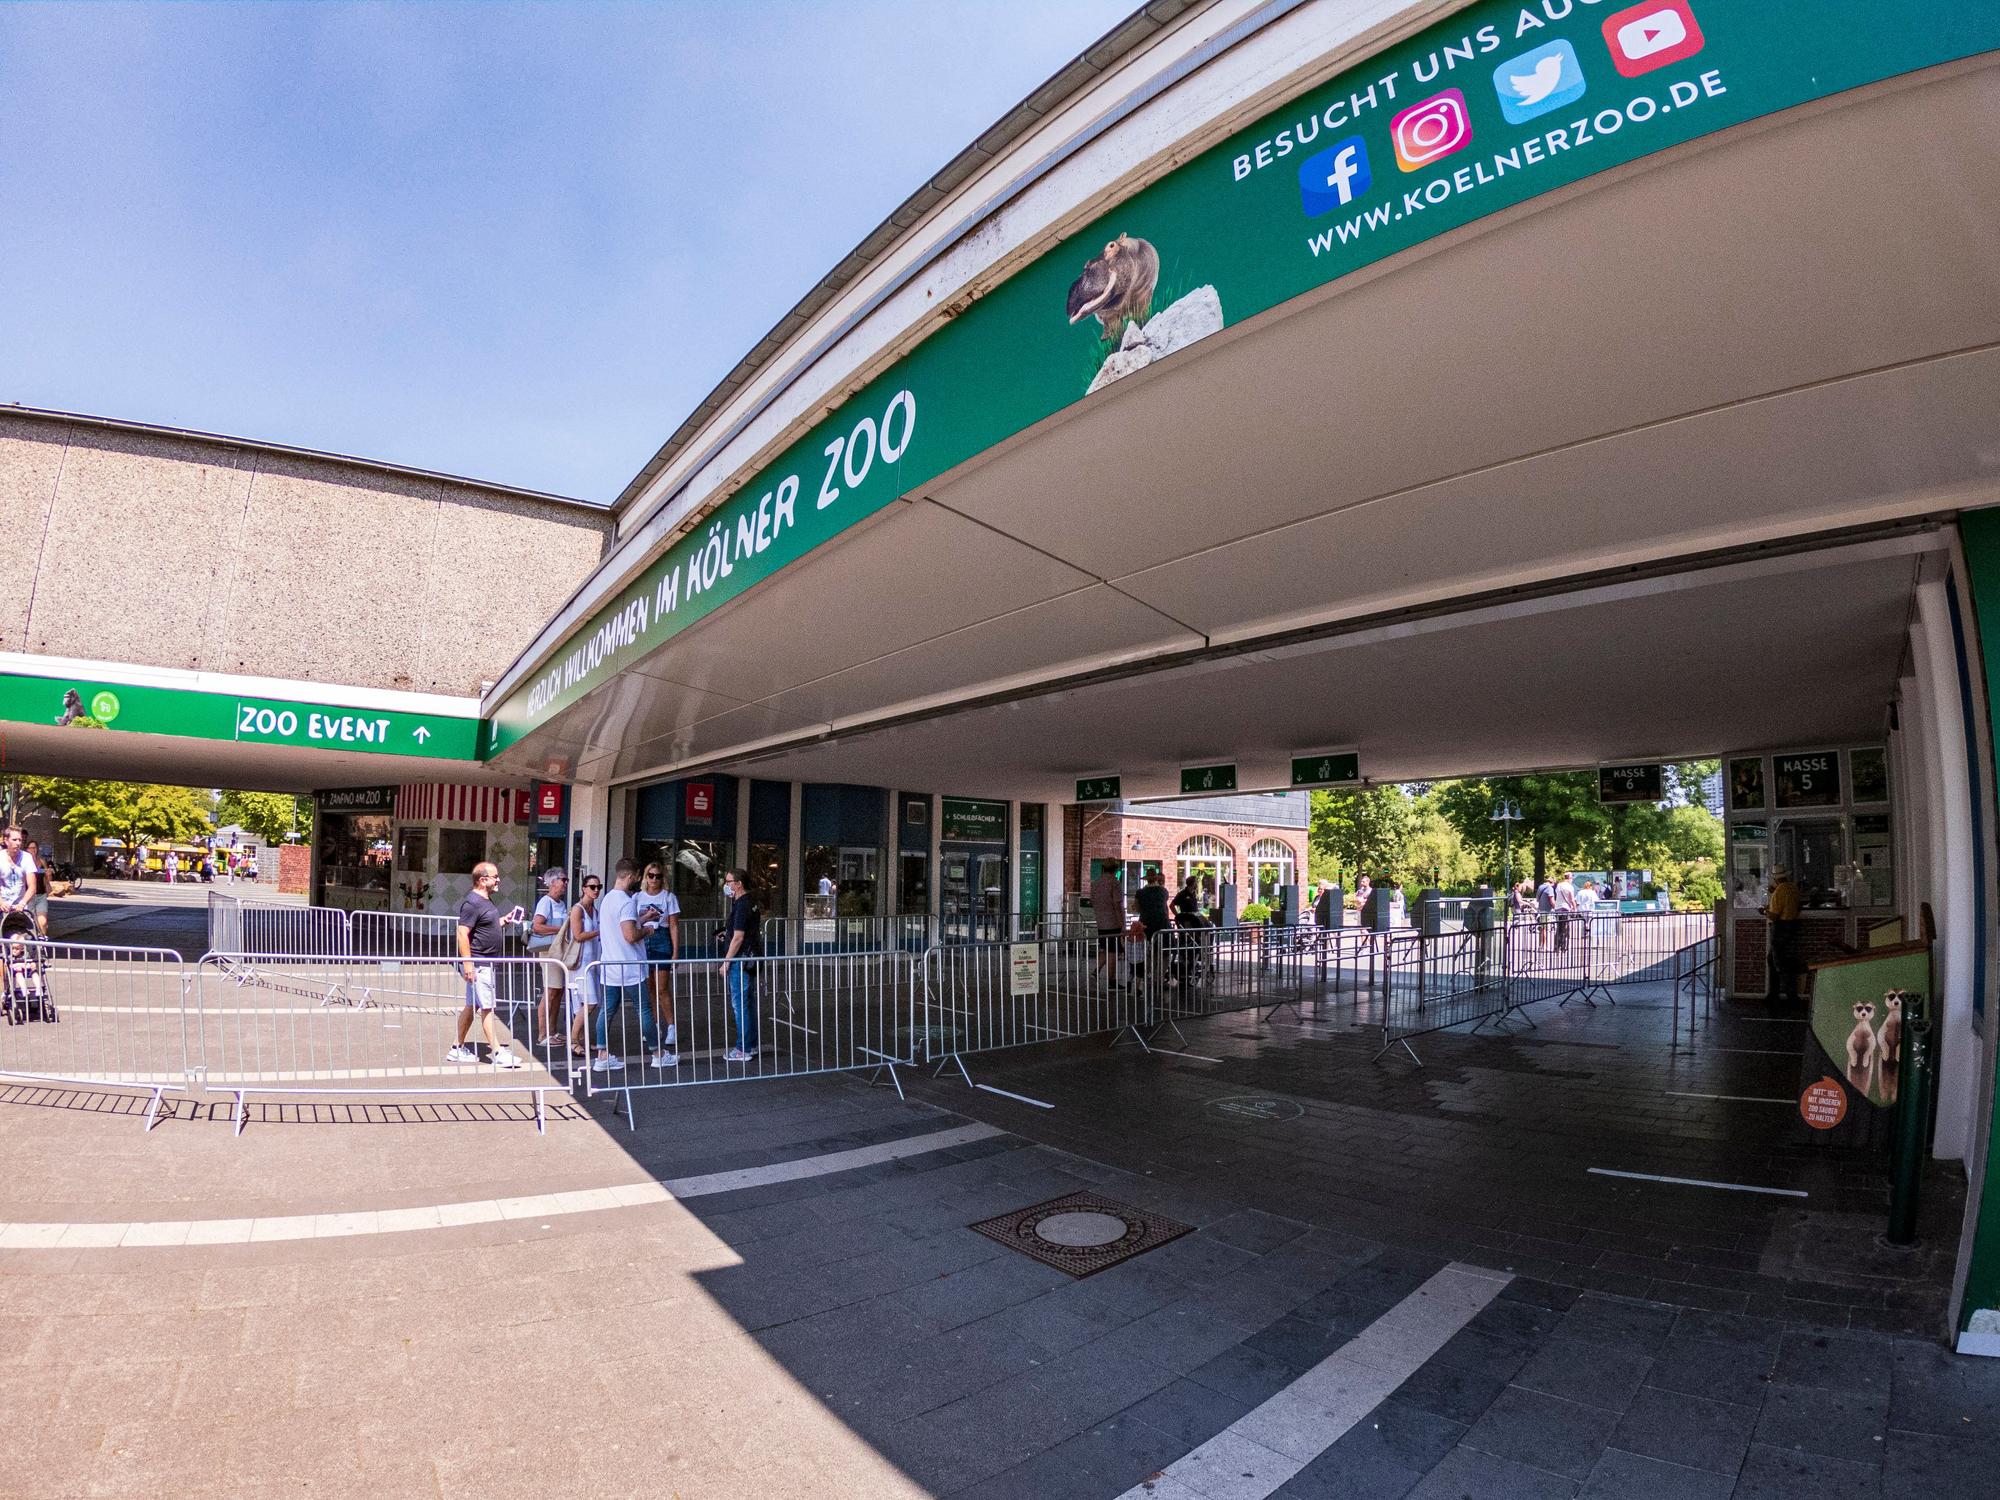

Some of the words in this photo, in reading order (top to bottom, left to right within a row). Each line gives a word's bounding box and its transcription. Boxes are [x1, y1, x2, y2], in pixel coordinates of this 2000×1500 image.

[1232, 71, 1399, 182] BESUCHT
[1412, 38, 1500, 83] UNS
[1514, 0, 1602, 38] AU
[1307, 70, 1727, 257] WWW.KOELNERZOO.DE
[564, 595, 649, 687] WILLKOMMEN
[655, 565, 679, 623] IM
[686, 474, 800, 601] KÖLNER
[817, 390, 916, 510] ZOO
[239, 706, 298, 736] ZOO
[308, 713, 391, 744] EVENT
[1613, 767, 1646, 778] KASSE
[1783, 757, 1829, 772] KASSE
[1626, 778, 1634, 790] 6
[1802, 774, 1813, 791] 5
[365, 790, 380, 805] ZOO
